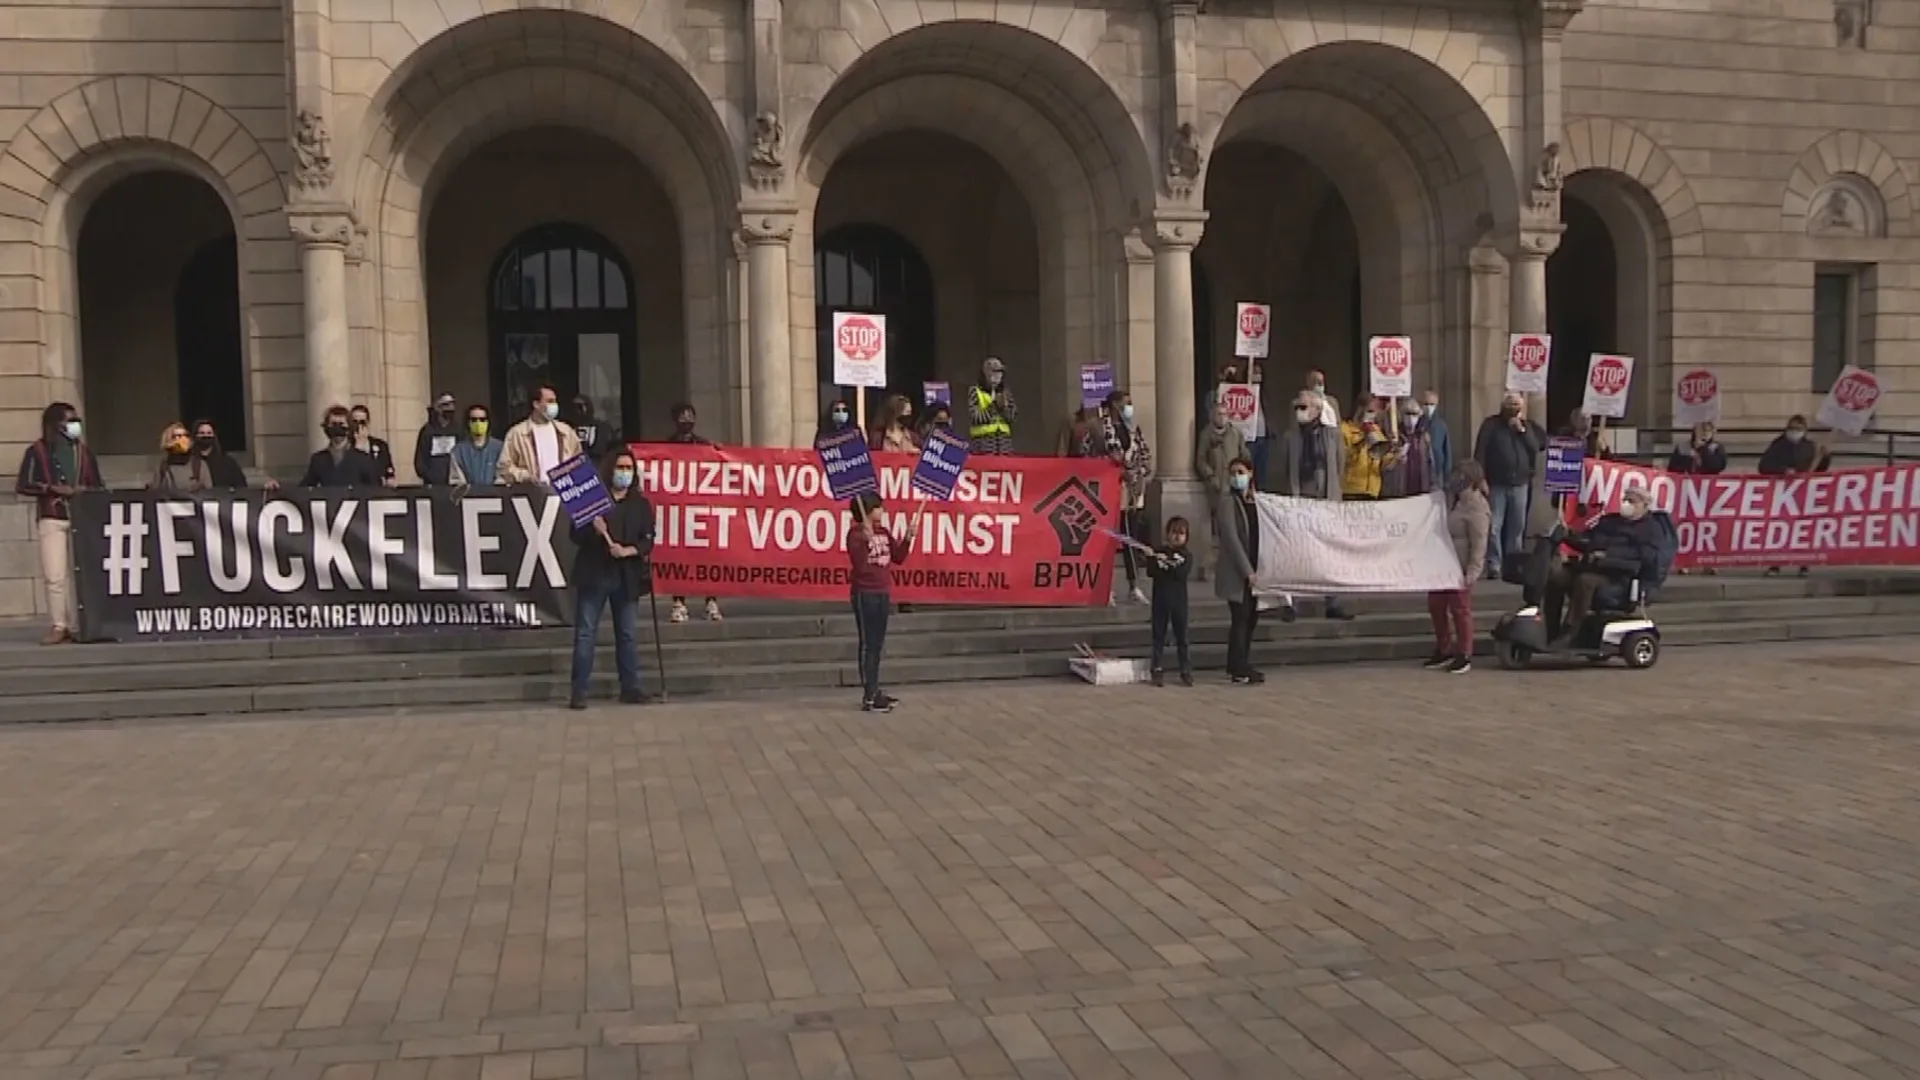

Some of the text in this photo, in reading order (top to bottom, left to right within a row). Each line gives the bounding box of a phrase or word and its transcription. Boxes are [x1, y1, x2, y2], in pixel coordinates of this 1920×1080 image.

[1241, 314, 1266, 331] STOP
[840, 326, 879, 347] STOP
[1375, 347, 1406, 364] STOP
[1513, 345, 1545, 361] STOP
[1594, 366, 1626, 382] STOP
[1680, 378, 1715, 395] STOP
[1841, 380, 1877, 400] STOP
[1223, 395, 1252, 412] STOP
[821, 447, 841, 461] Wij
[928, 438, 945, 455] Wij
[826, 453, 869, 475] Blijven!
[922, 450, 961, 475] Blijven!
[554, 473, 575, 490] Wij
[560, 475, 600, 502] Blijven!
[636, 459, 766, 498] HUIZEN
[879, 467, 1024, 505] MSEN
[745, 507, 853, 552] VOO
[1731, 511, 1918, 553] IEDEREEN
[103, 496, 567, 596] #FUCKFLEX
[652, 562, 1010, 592] WW.BONDPRECAIRENVORMEN.NL
[1034, 562, 1101, 591] BPW
[136, 603, 542, 633] WWW.BONDPRECAIREWOONVORMEN.NL
